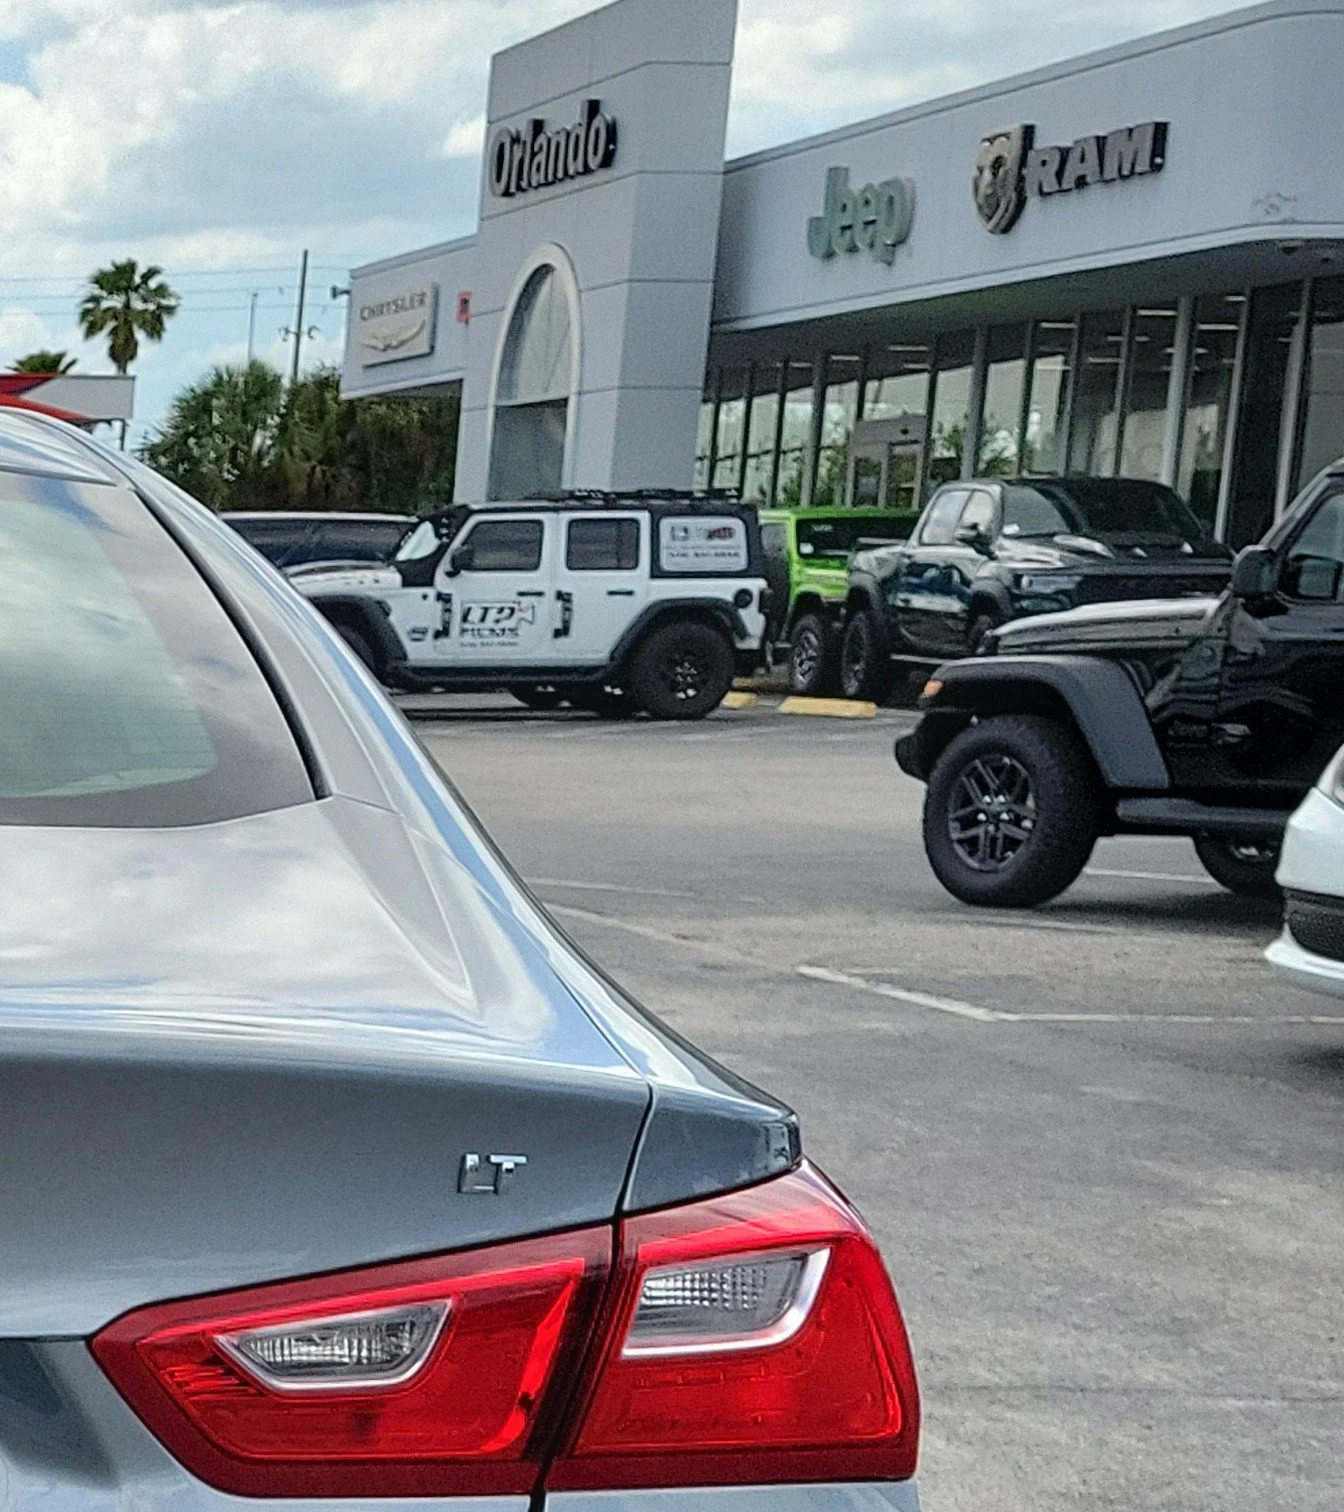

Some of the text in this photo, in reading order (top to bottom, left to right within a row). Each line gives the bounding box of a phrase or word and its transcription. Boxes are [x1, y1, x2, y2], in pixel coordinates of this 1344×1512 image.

[489, 99, 617, 197] Orlando
[1027, 123, 1167, 197] RAM
[807, 166, 915, 266] Jeep
[458, 1152, 529, 1195] LT
